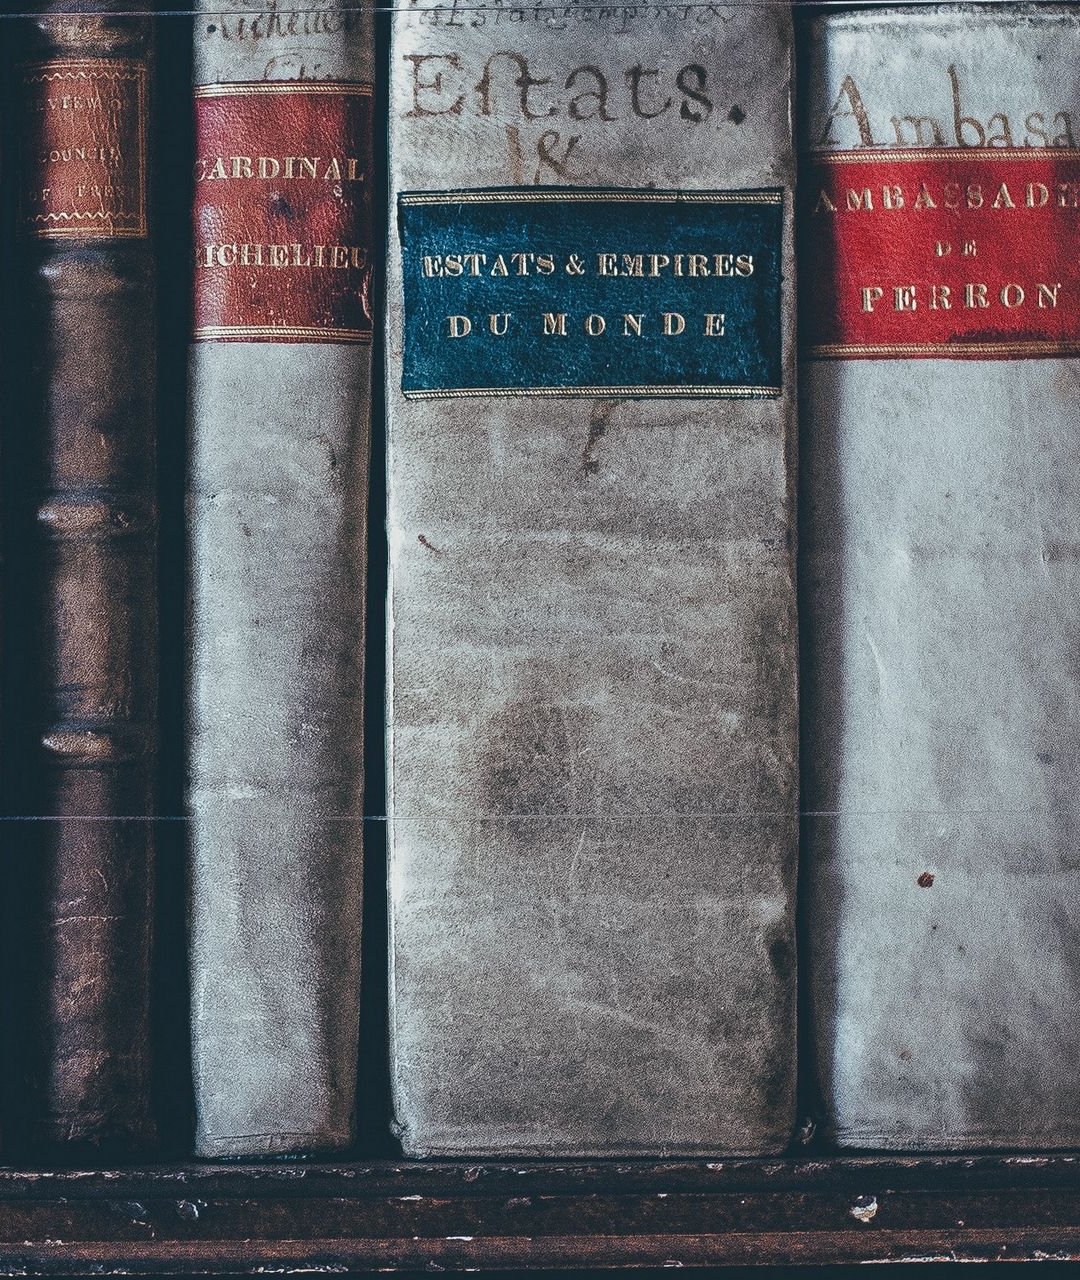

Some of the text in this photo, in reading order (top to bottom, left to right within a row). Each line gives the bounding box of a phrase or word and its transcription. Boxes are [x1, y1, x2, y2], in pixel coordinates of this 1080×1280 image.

[194, 155, 366, 182] CARDINAL
[421, 253, 754, 279] ESTATS & EMPIRES
[860, 281, 1062, 313] PERRON
[446, 313, 727, 339] DU MONDE
